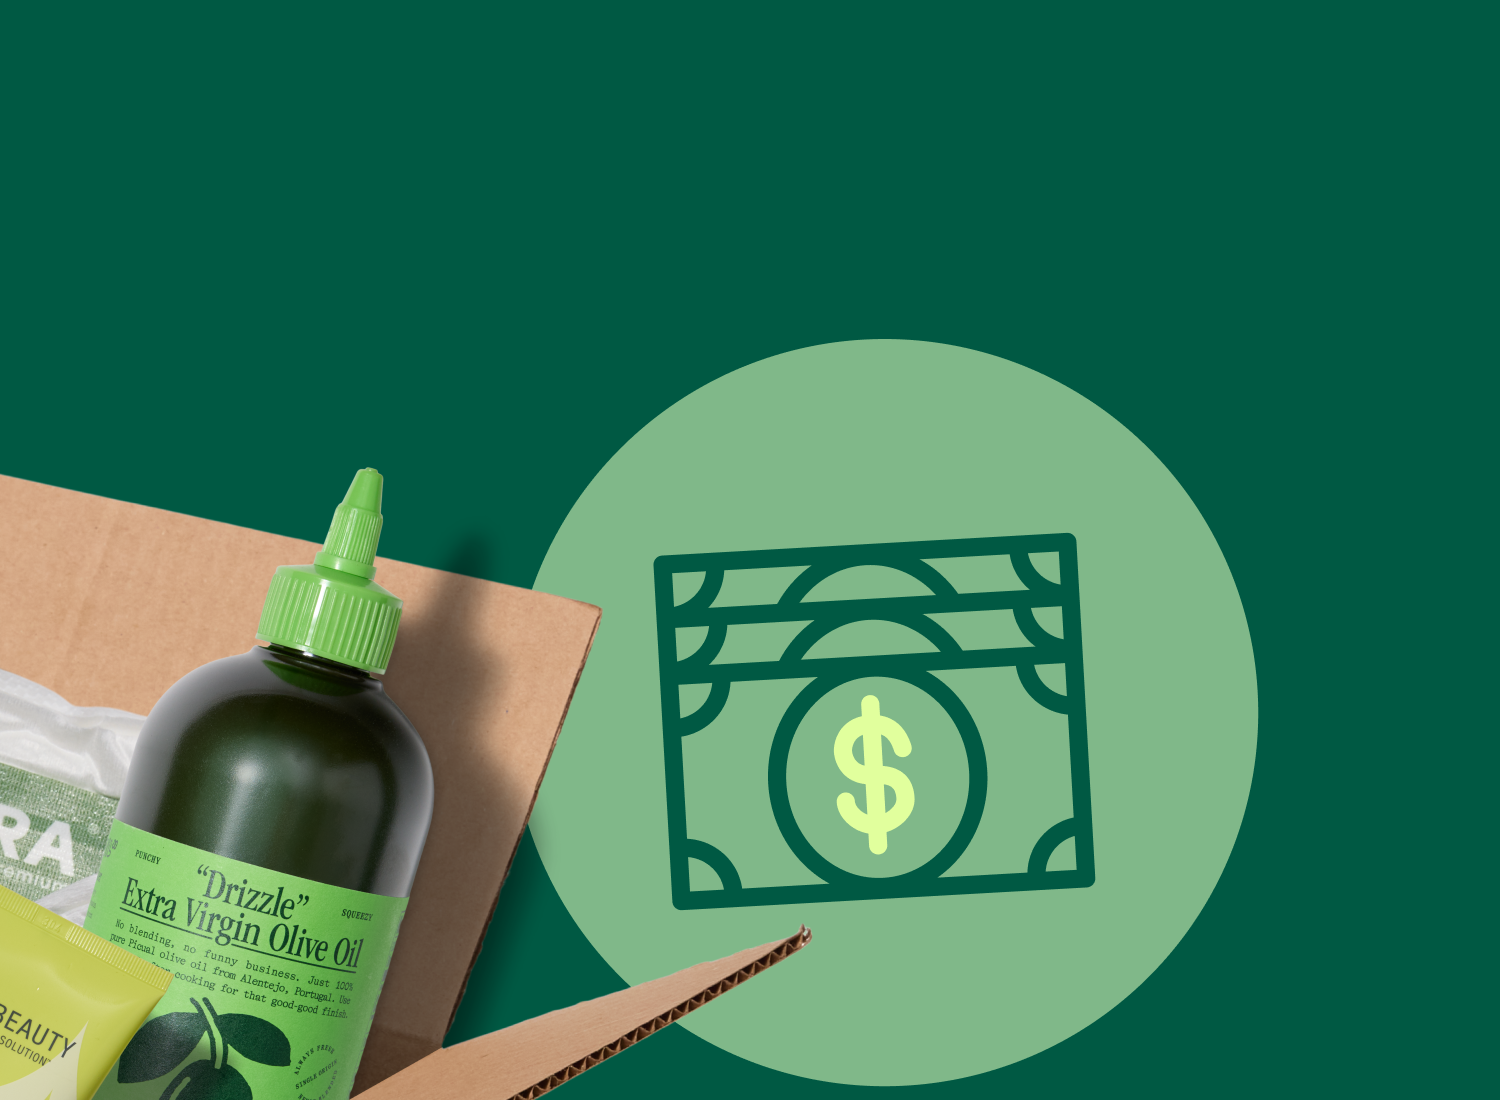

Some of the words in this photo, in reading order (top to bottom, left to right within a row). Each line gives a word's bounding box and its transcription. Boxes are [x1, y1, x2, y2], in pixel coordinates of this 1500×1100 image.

[135, 850, 161, 865] PUNCHY
[121, 877, 177, 921] Extra
[187, 897, 259, 946] Virgin
[269, 923, 328, 962] Olive
[334, 938, 364, 968] Oil
[342, 908, 373, 922] SQUEEZY
[109, 933, 125, 945] pure
[128, 938, 155, 955] Picual
[160, 951, 186, 965] olive
[190, 960, 207, 972] oil
[212, 966, 236, 980] from
[240, 974, 288, 994] Alentejo,
[294, 987, 334, 1002] Portugal.
[115, 919, 124, 929] No
[129, 924, 174, 948] blending,
[183, 944, 196, 953] no
[204, 949, 238, 966] funny
[246, 960, 299, 981] business.
[308, 976, 330, 987] Just
[336, 981, 353, 991] 100%
[174, 971, 216, 991] cooking
[220, 983, 239, 995] for
[244, 990, 266, 1003] that
[271, 998, 318, 1014] good-good
[321, 1007, 348, 1018] finish.
